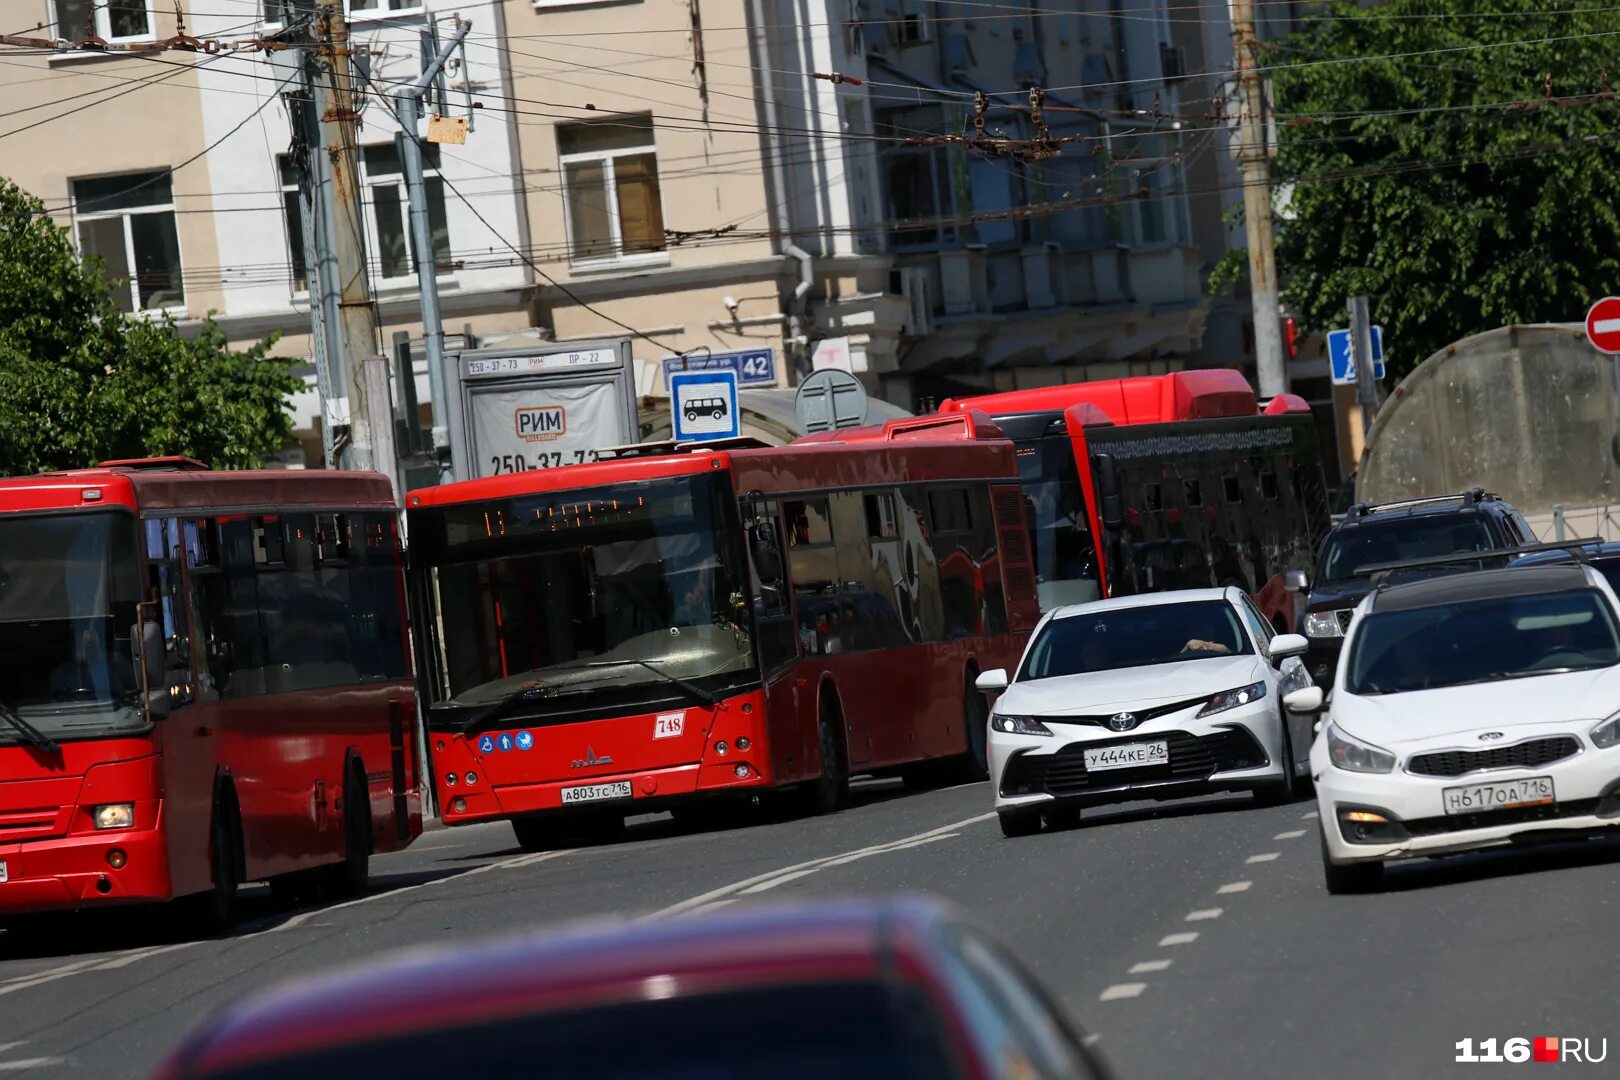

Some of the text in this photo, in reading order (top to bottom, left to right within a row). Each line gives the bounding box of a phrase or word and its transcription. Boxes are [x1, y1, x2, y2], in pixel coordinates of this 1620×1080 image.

[743, 356, 768, 376] 42
[520, 411, 561, 433] РИМ
[658, 718, 681, 733] 748
